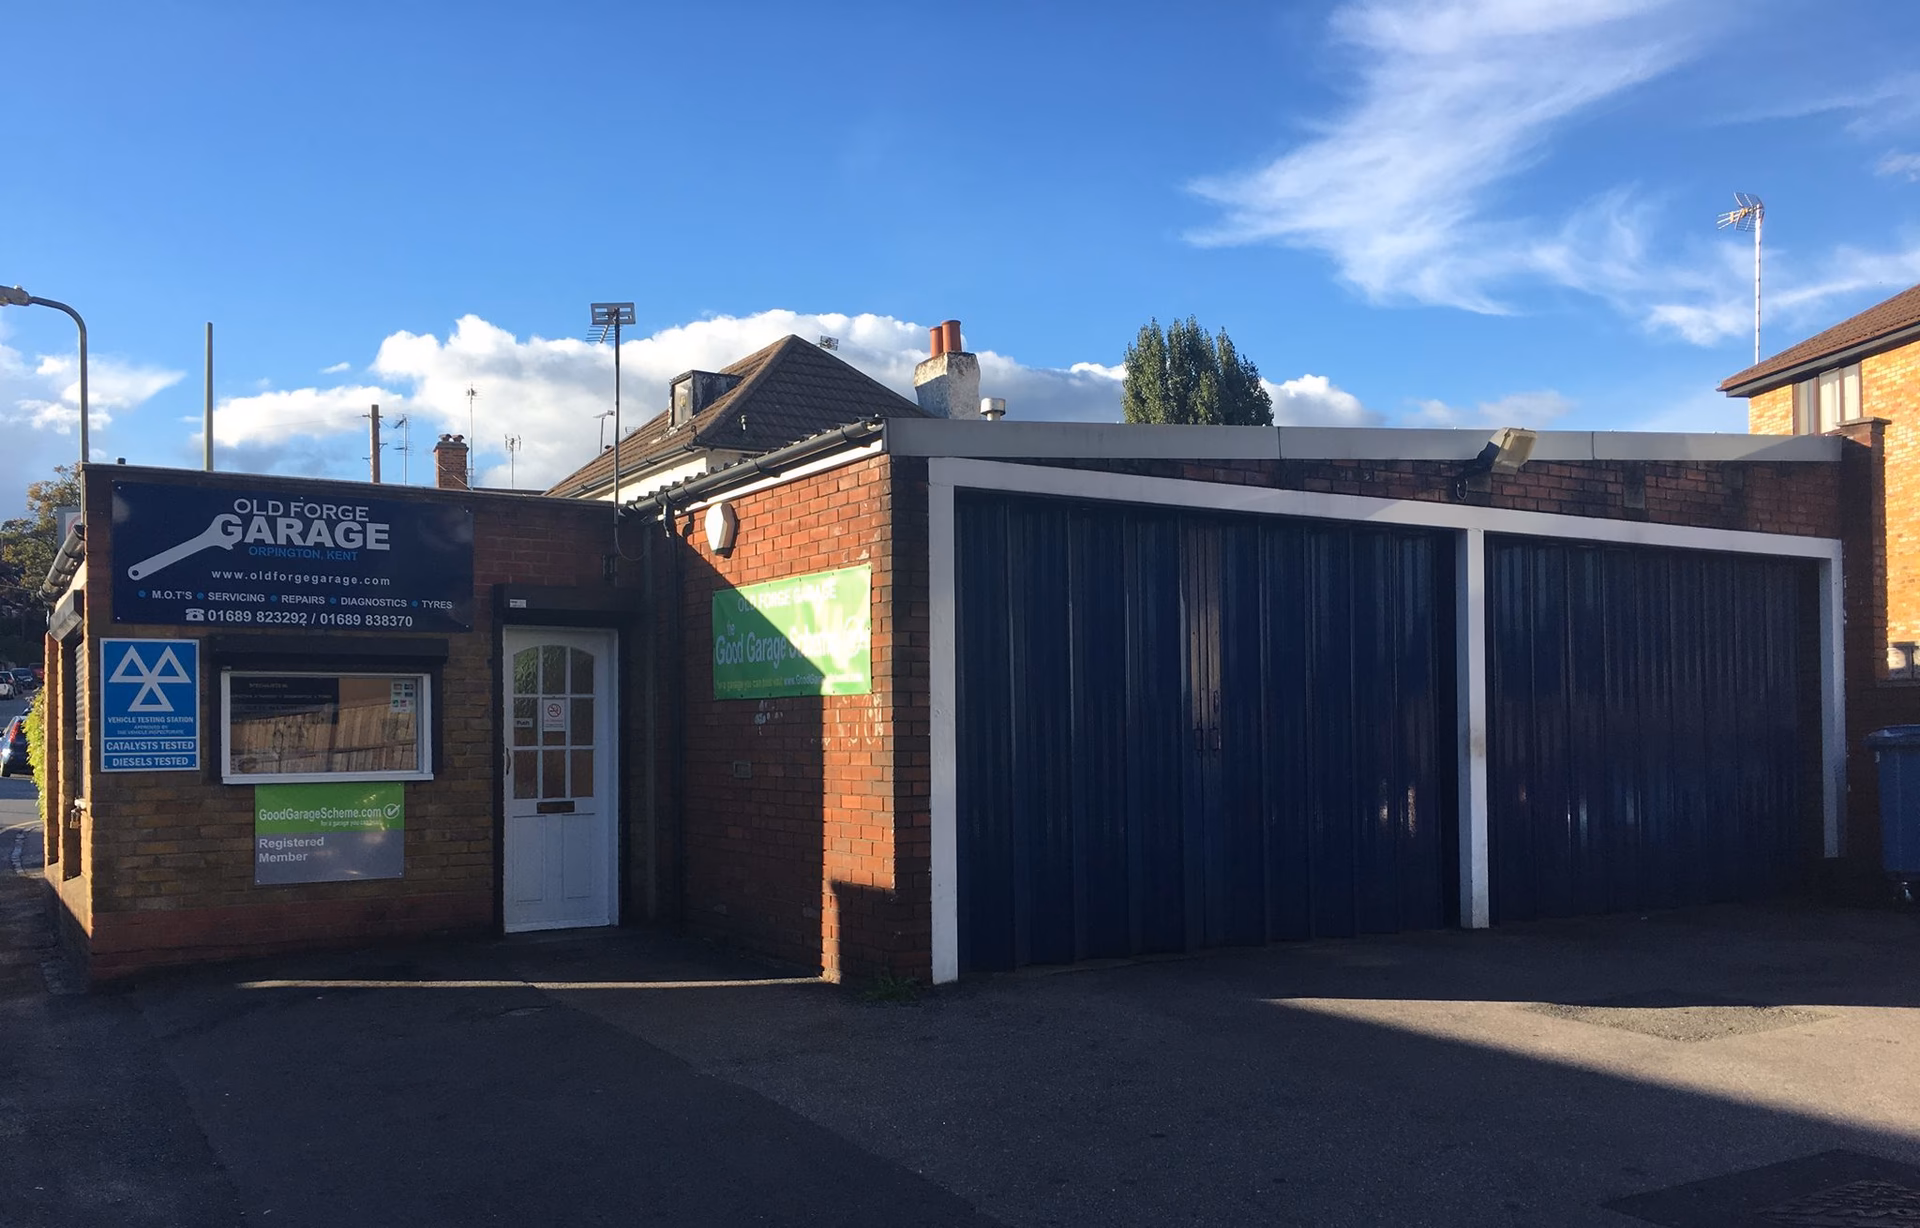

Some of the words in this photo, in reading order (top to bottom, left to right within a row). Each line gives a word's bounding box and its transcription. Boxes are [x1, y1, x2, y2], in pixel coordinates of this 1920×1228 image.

[234, 498, 283, 516] OLD
[290, 501, 369, 521] FORGE
[217, 514, 390, 551] GARAGE
[249, 546, 324, 561] ORPINGTON,
[327, 550, 359, 561] KENT
[211, 570, 391, 586] www.oldforgegarage.com
[152, 590, 193, 600] M.O.T'S
[208, 592, 265, 603] SERVICING
[281, 594, 326, 605] REPAIRS
[340, 597, 407, 608] DIAGNOSTICS
[421, 600, 453, 609] TYRES
[208, 609, 252, 623] 01689
[256, 611, 307, 624] 823292
[320, 613, 361, 626] 01689
[365, 615, 413, 627] 838370
[715, 634, 744, 665] Good
[746, 631, 787, 669] Garage
[106, 742, 158, 751] CATALYSTS
[160, 741, 194, 750] TESTED
[112, 757, 152, 767] DIESELS
[154, 757, 189, 765] TESTED
[259, 807, 382, 822] GoodGarageScheme.com
[259, 837, 324, 850] Registered
[259, 852, 308, 863] Member
